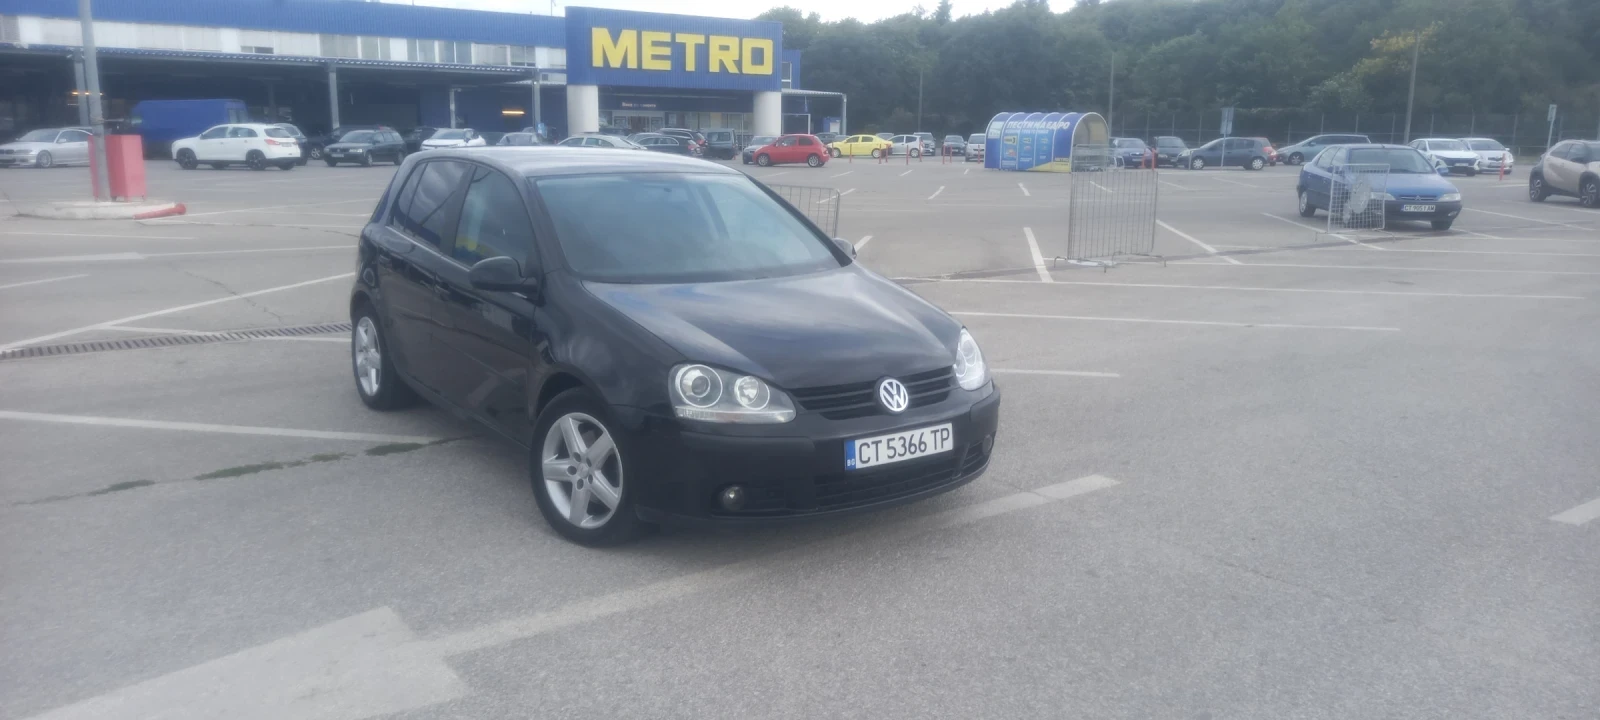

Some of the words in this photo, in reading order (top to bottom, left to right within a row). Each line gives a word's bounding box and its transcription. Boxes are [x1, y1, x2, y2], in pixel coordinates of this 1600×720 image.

[591, 27, 773, 75] METRO
[847, 459, 855, 467] BG
[859, 440, 882, 464] CT
[886, 432, 927, 459] 5366
[930, 427, 950, 451] TP
